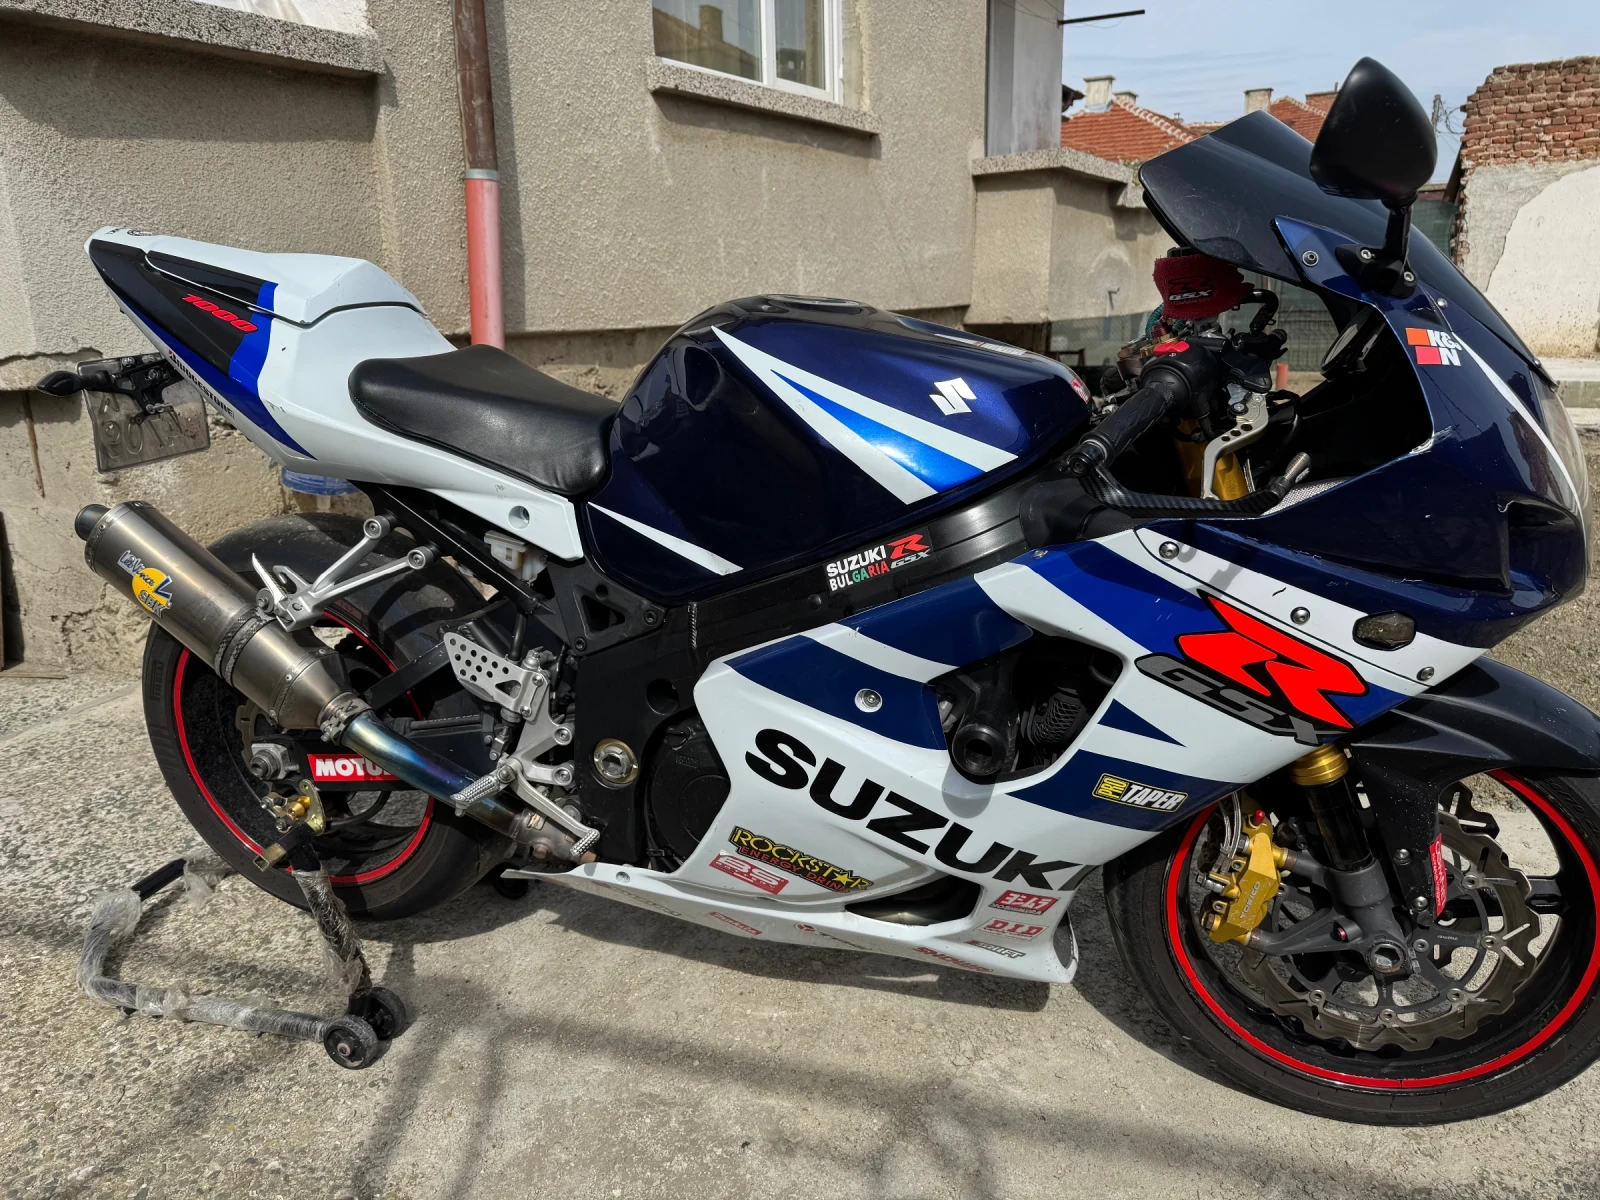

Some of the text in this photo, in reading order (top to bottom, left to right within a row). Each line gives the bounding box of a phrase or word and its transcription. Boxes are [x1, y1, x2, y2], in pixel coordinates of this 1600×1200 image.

[182, 293, 258, 332] 1000
[169, 349, 236, 419] BRIDGESTONE
[826, 545, 887, 578] SUZUKI
[829, 560, 891, 592] BULGARIA
[890, 549, 931, 570] GSX
[1135, 652, 1348, 746] GSX
[744, 727, 1101, 892] SUZUKI
[1095, 776, 1185, 811] PRO TAPER
[739, 846, 802, 872] ENERGY
